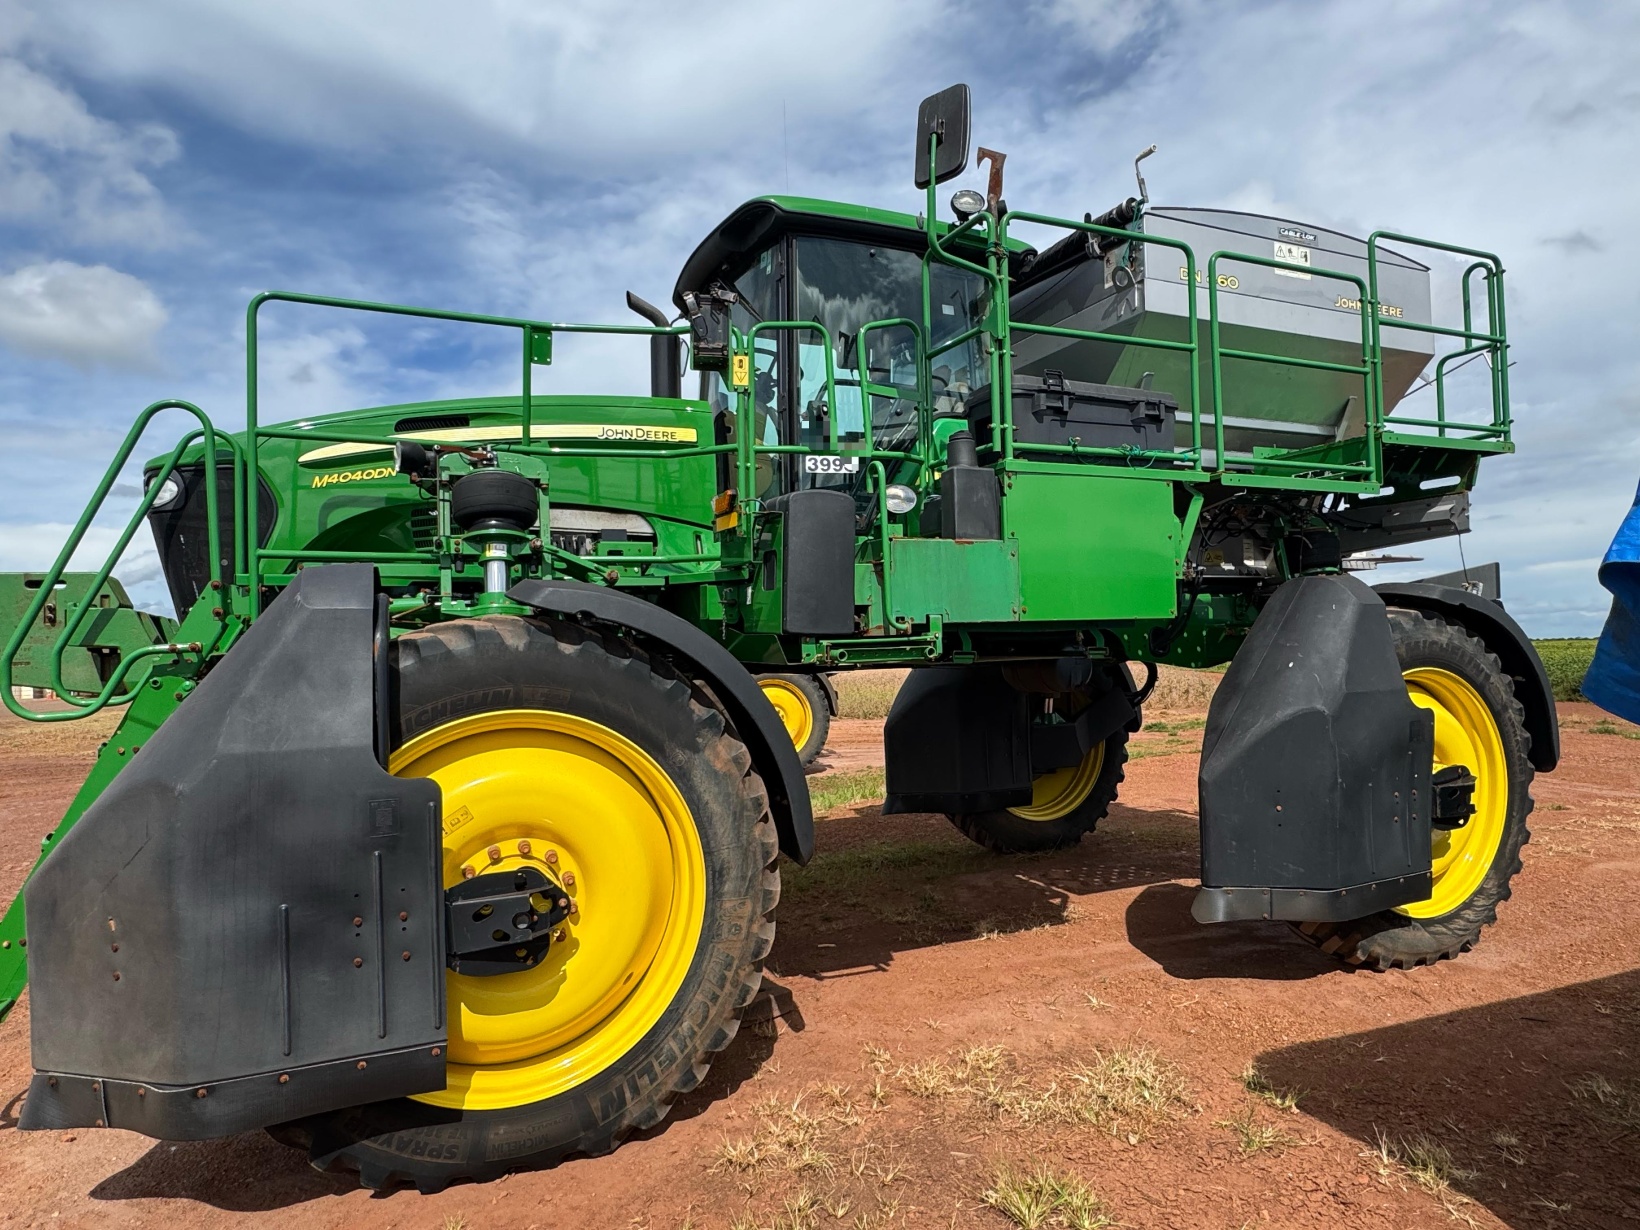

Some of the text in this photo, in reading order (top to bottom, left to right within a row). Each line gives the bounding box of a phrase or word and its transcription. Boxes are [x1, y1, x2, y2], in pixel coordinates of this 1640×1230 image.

[1206, 273, 1240, 290] 60
[598, 427, 678, 440] JOHN DEERE
[807, 457, 853, 472] 399
[312, 467, 397, 489] M4040DN
[404, 687, 513, 735] ICHELIN
[600, 952, 735, 1122] MICHELIN
[491, 1133, 549, 1154] MICHELIN
